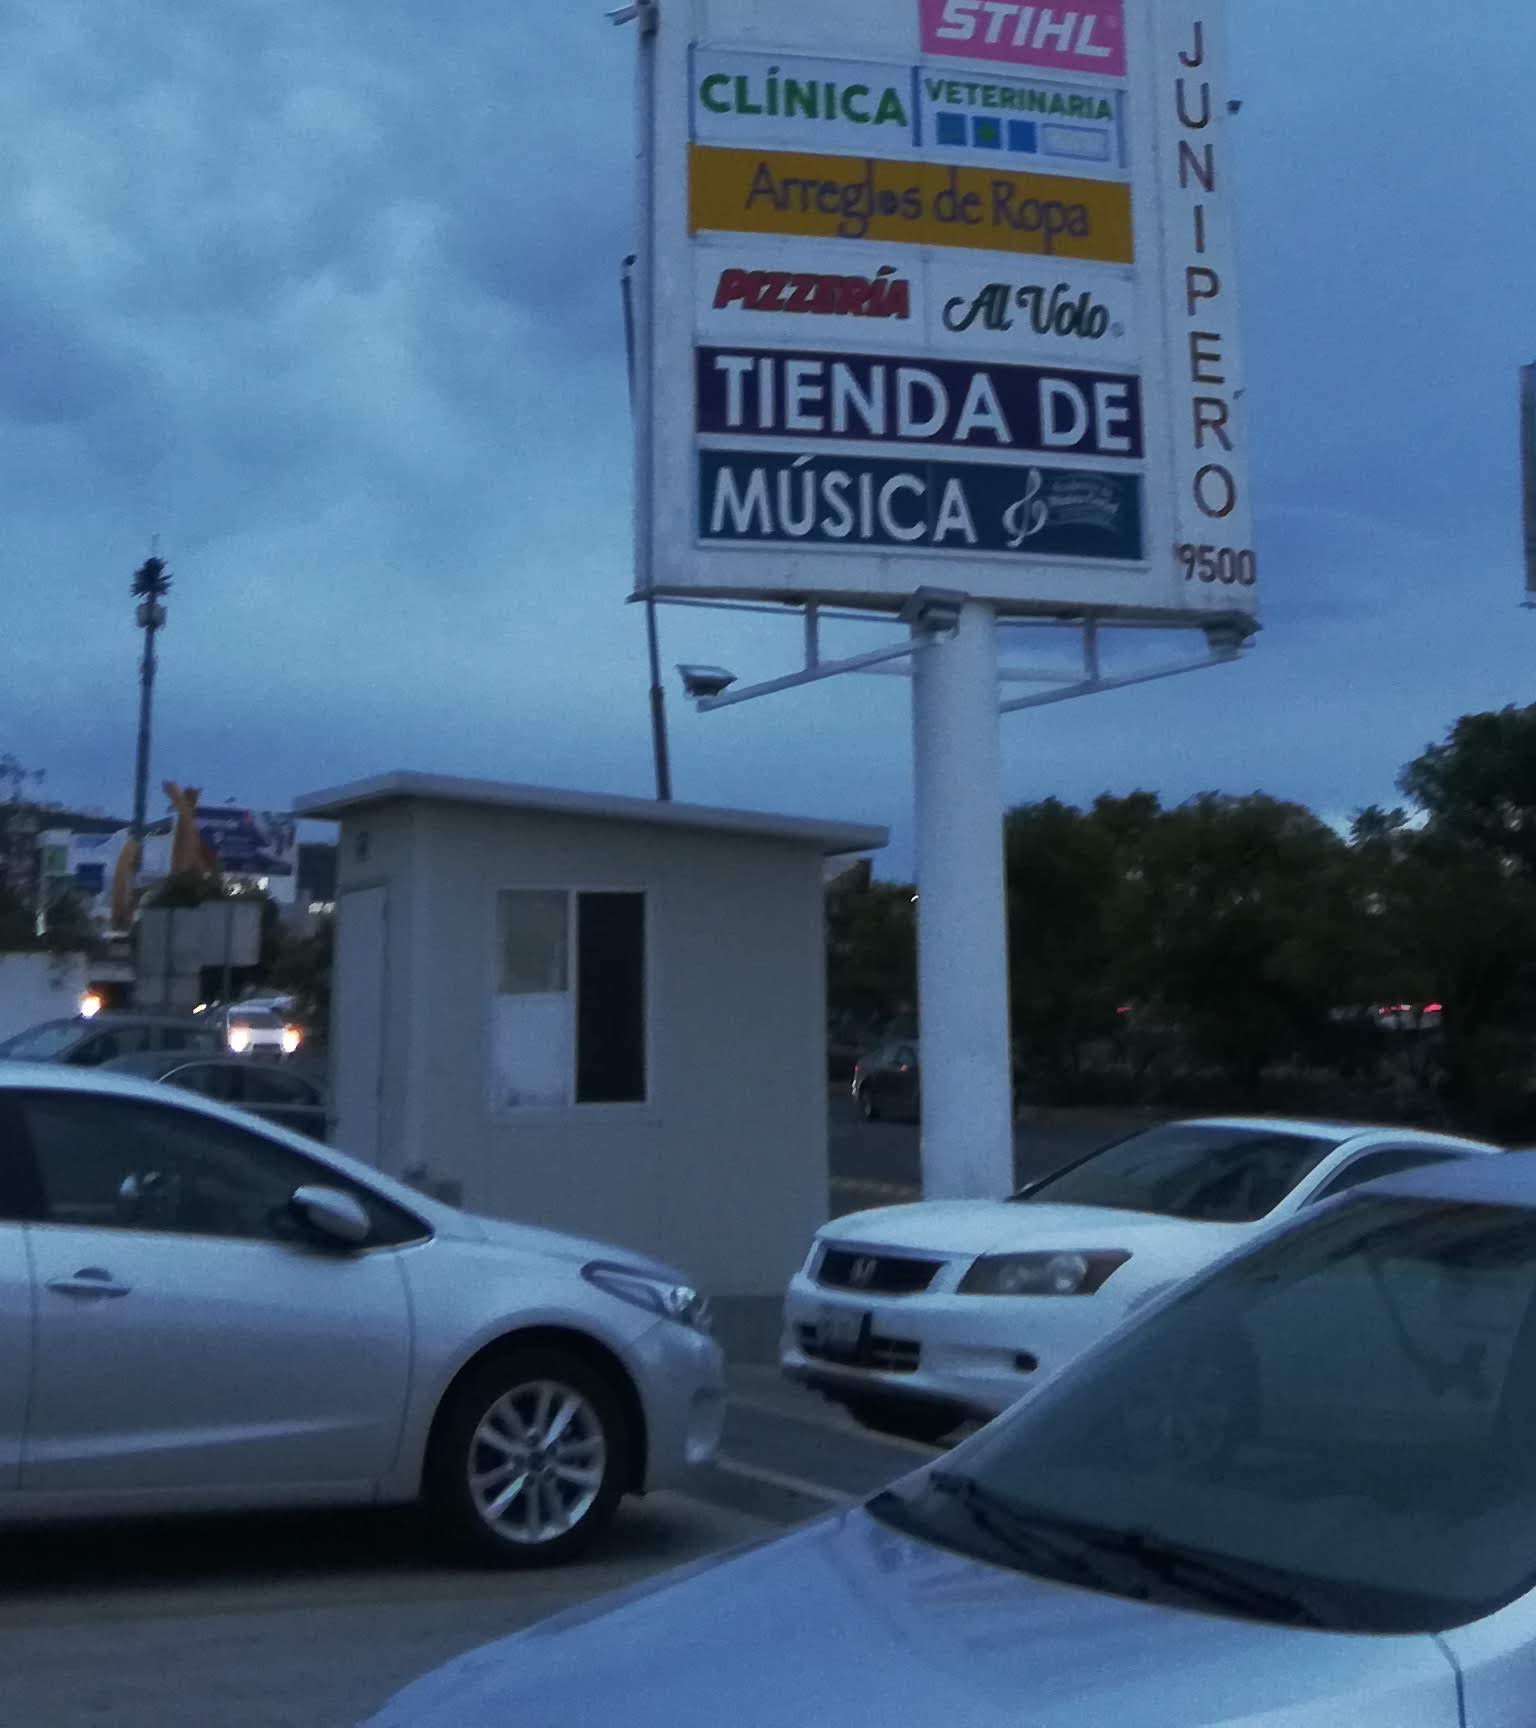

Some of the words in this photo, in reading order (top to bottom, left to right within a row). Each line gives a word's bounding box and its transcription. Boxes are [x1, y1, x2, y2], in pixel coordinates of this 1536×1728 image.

[700, 66, 909, 126] CLÍNICA
[925, 77, 1113, 120] VETERINARIA
[744, 160, 923, 238] Arreglos
[932, 164, 981, 226] de
[991, 180, 1090, 255] Ropa
[713, 265, 910, 319] PIZZERÍA
[1175, 20, 1237, 518] JUNIPERO
[1015, 283, 1110, 339] Volo
[714, 355, 1012, 444] TIENDA
[1038, 376, 1132, 452] DE
[711, 455, 979, 544] MÚSICA
[1178, 542, 1256, 587] 9500
